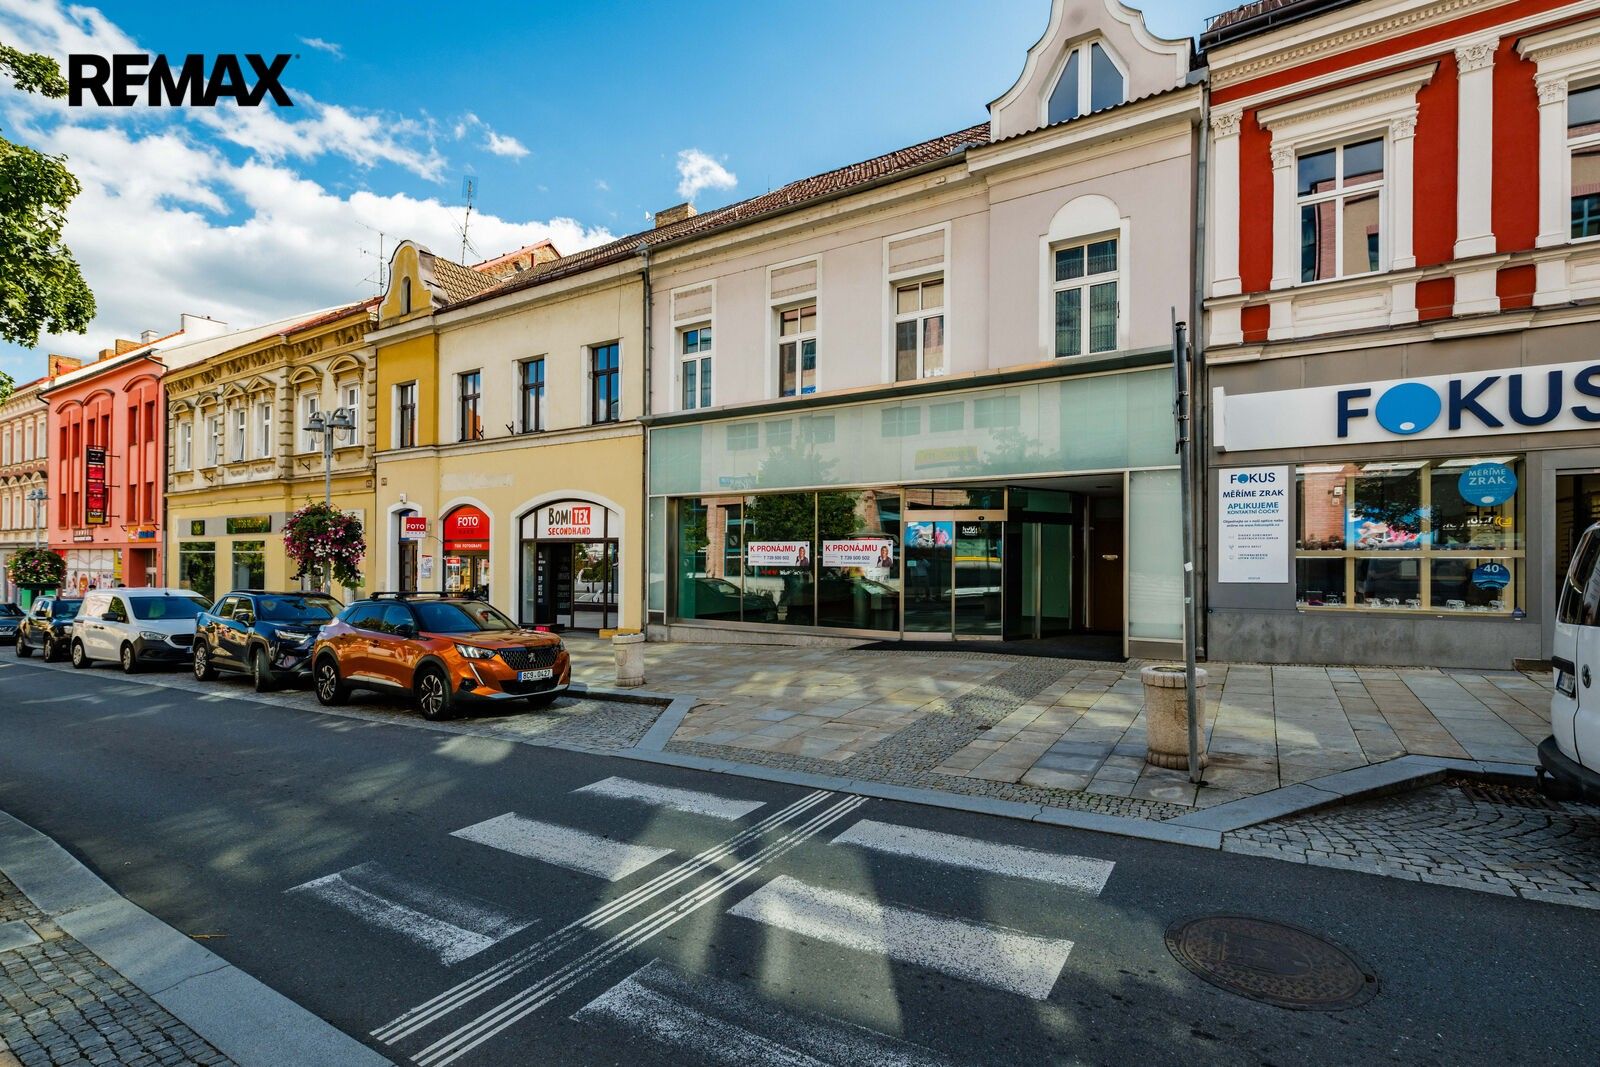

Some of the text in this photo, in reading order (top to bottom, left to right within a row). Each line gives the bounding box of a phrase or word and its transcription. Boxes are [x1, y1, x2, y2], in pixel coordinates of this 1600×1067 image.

[1230, 472, 1276, 484] FOKUS
[1468, 476, 1506, 486] ZRAK
[1222, 489, 1284, 498] MĚŘÍME ZRAK
[1227, 502, 1279, 510] APLIKUJEME
[457, 516, 478, 527] FOTO
[547, 527, 591, 536] SECONDHAND
[756, 543, 796, 552] PRONÁJMU
[825, 542, 878, 552] K PRONÁJMU
